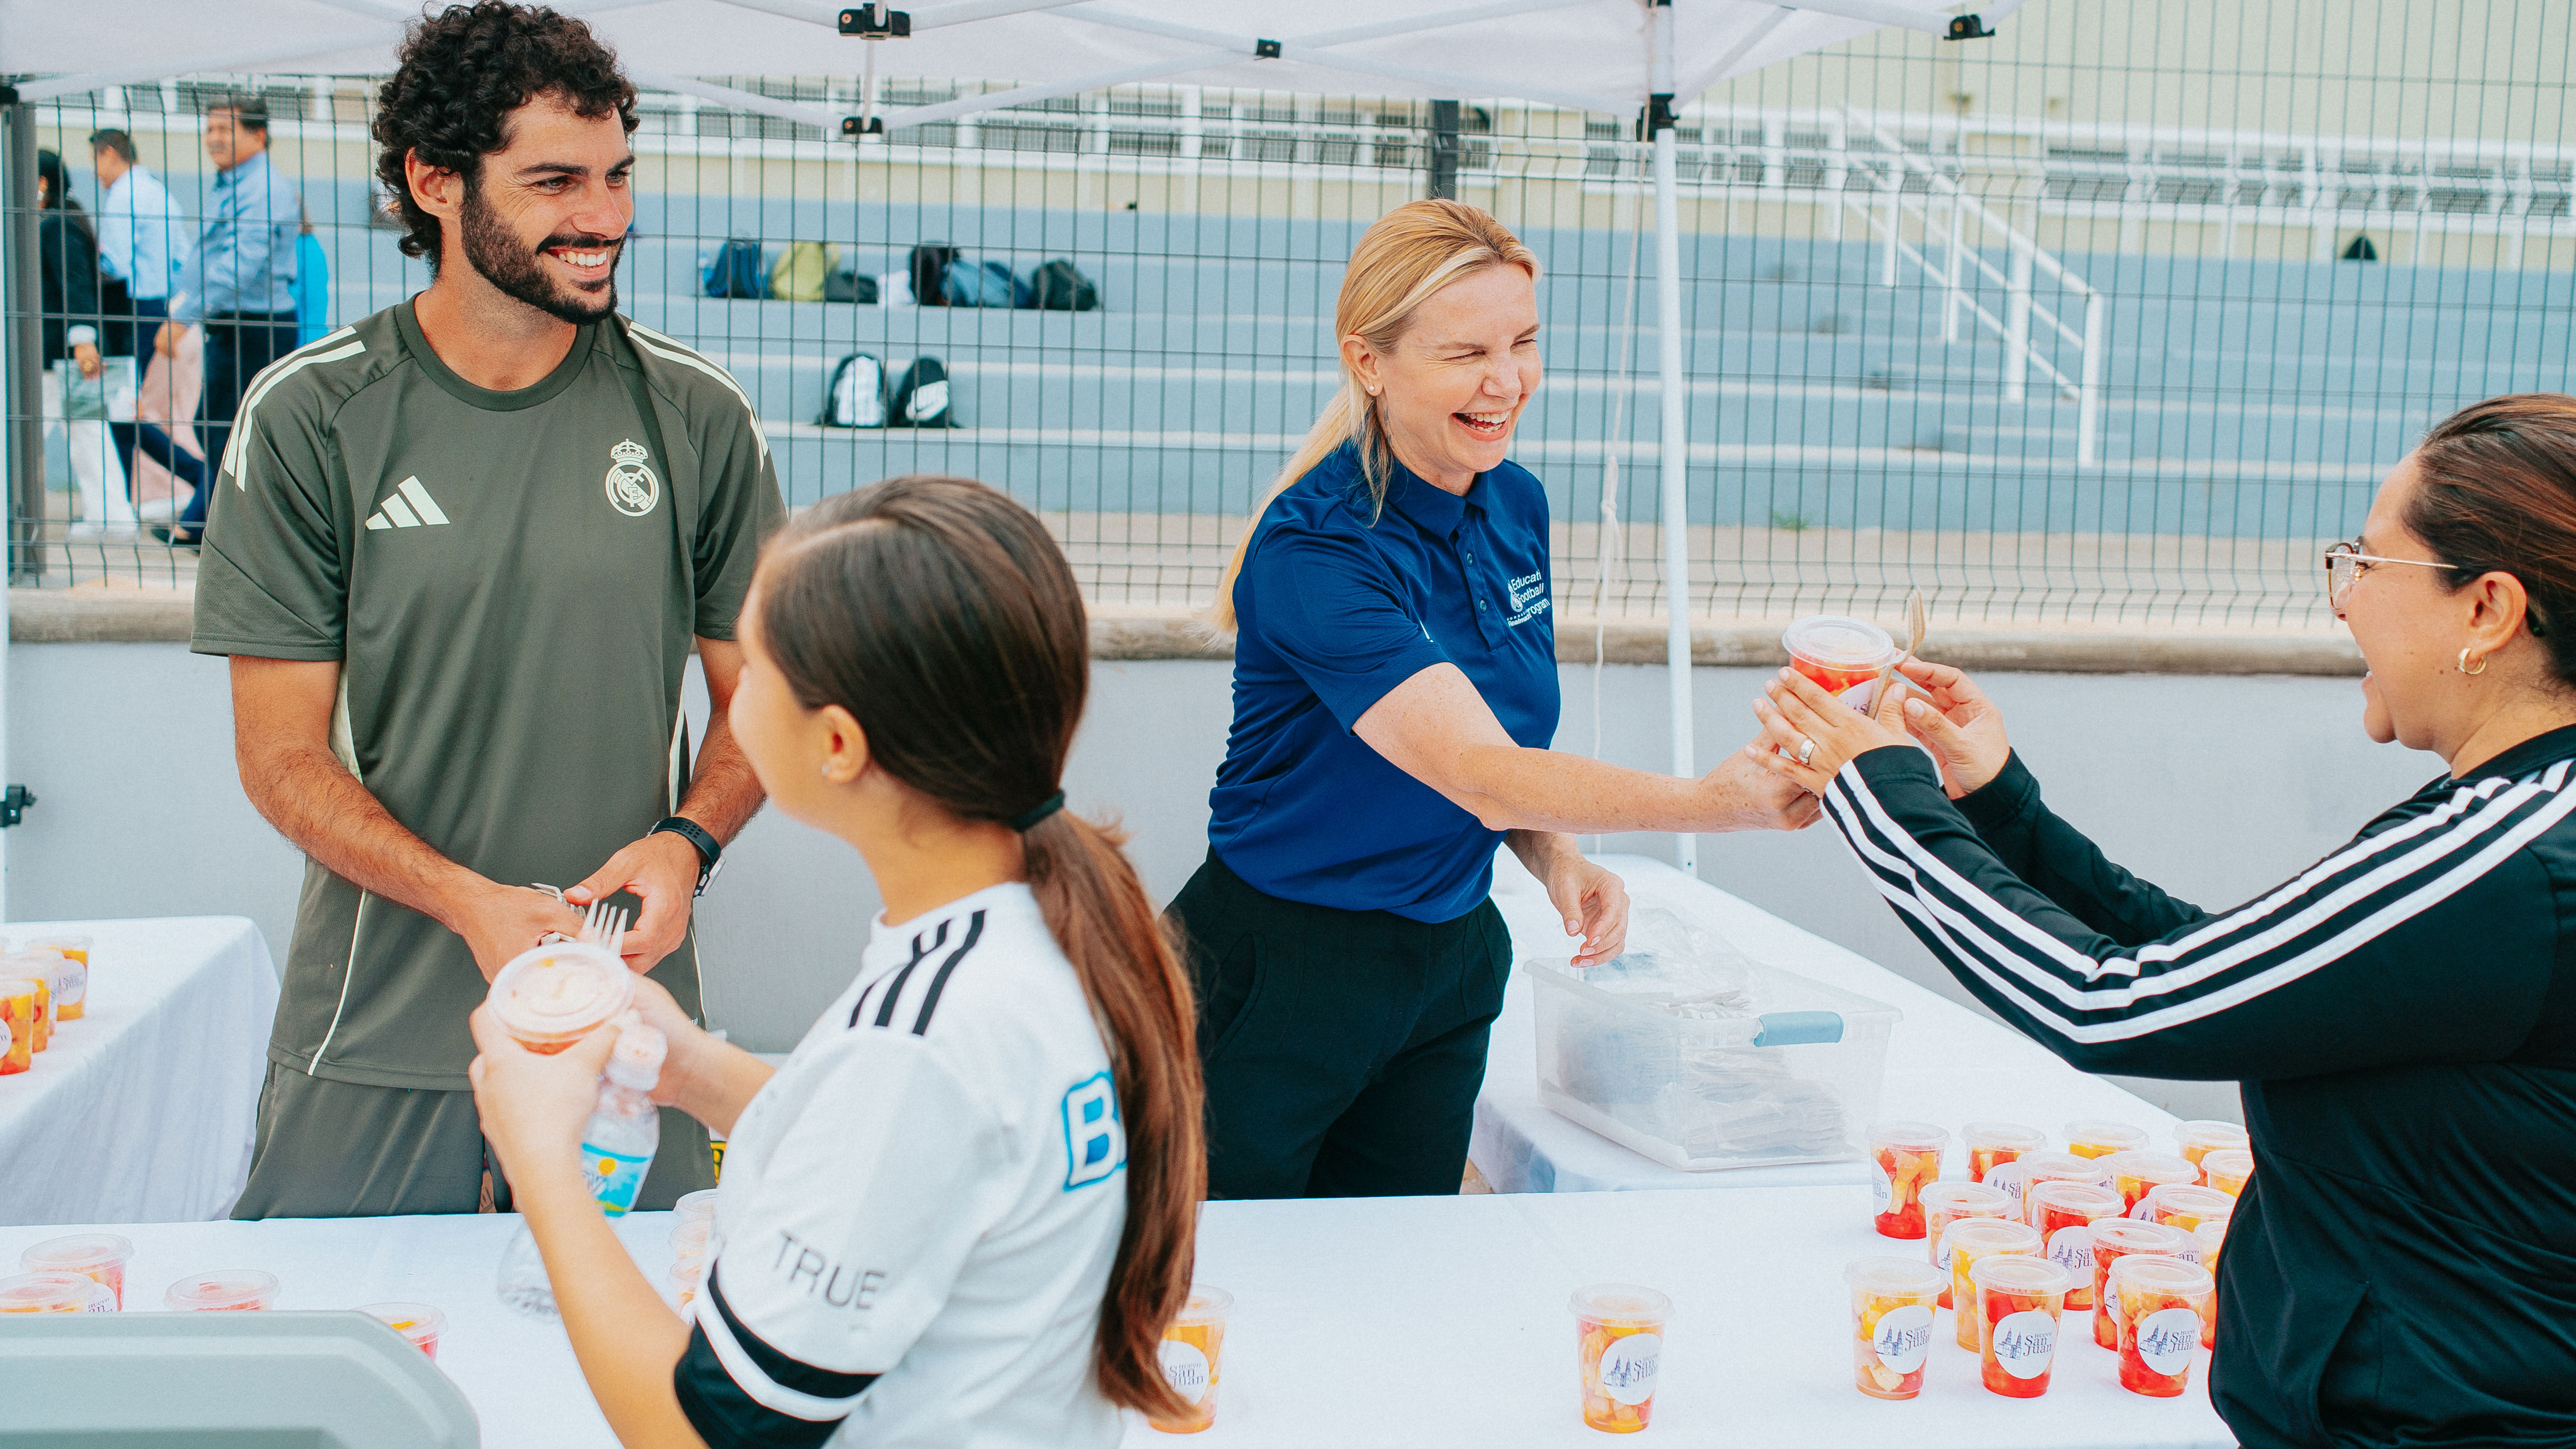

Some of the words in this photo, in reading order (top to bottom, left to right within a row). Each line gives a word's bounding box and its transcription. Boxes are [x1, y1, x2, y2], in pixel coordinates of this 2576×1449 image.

[1511, 569, 1542, 591] Educati
[1062, 1071, 1128, 1191] B
[2008, 1182, 2020, 1192] Sa
[2075, 1249, 2092, 1259] Sa
[2178, 1253, 2194, 1261] an
[775, 1230, 887, 1309] TRUE
[2074, 1259, 2092, 1269] Ju
[1905, 1330, 1926, 1340] San
[2024, 1335, 2047, 1346] San
[2170, 1332, 2190, 1343] San
[1905, 1334, 1929, 1352] Juan
[2168, 1341, 2194, 1354] Juan
[2023, 1344, 2051, 1357] Juan
[1169, 1366, 1195, 1378] San
[1173, 1375, 1203, 1389] Juan
